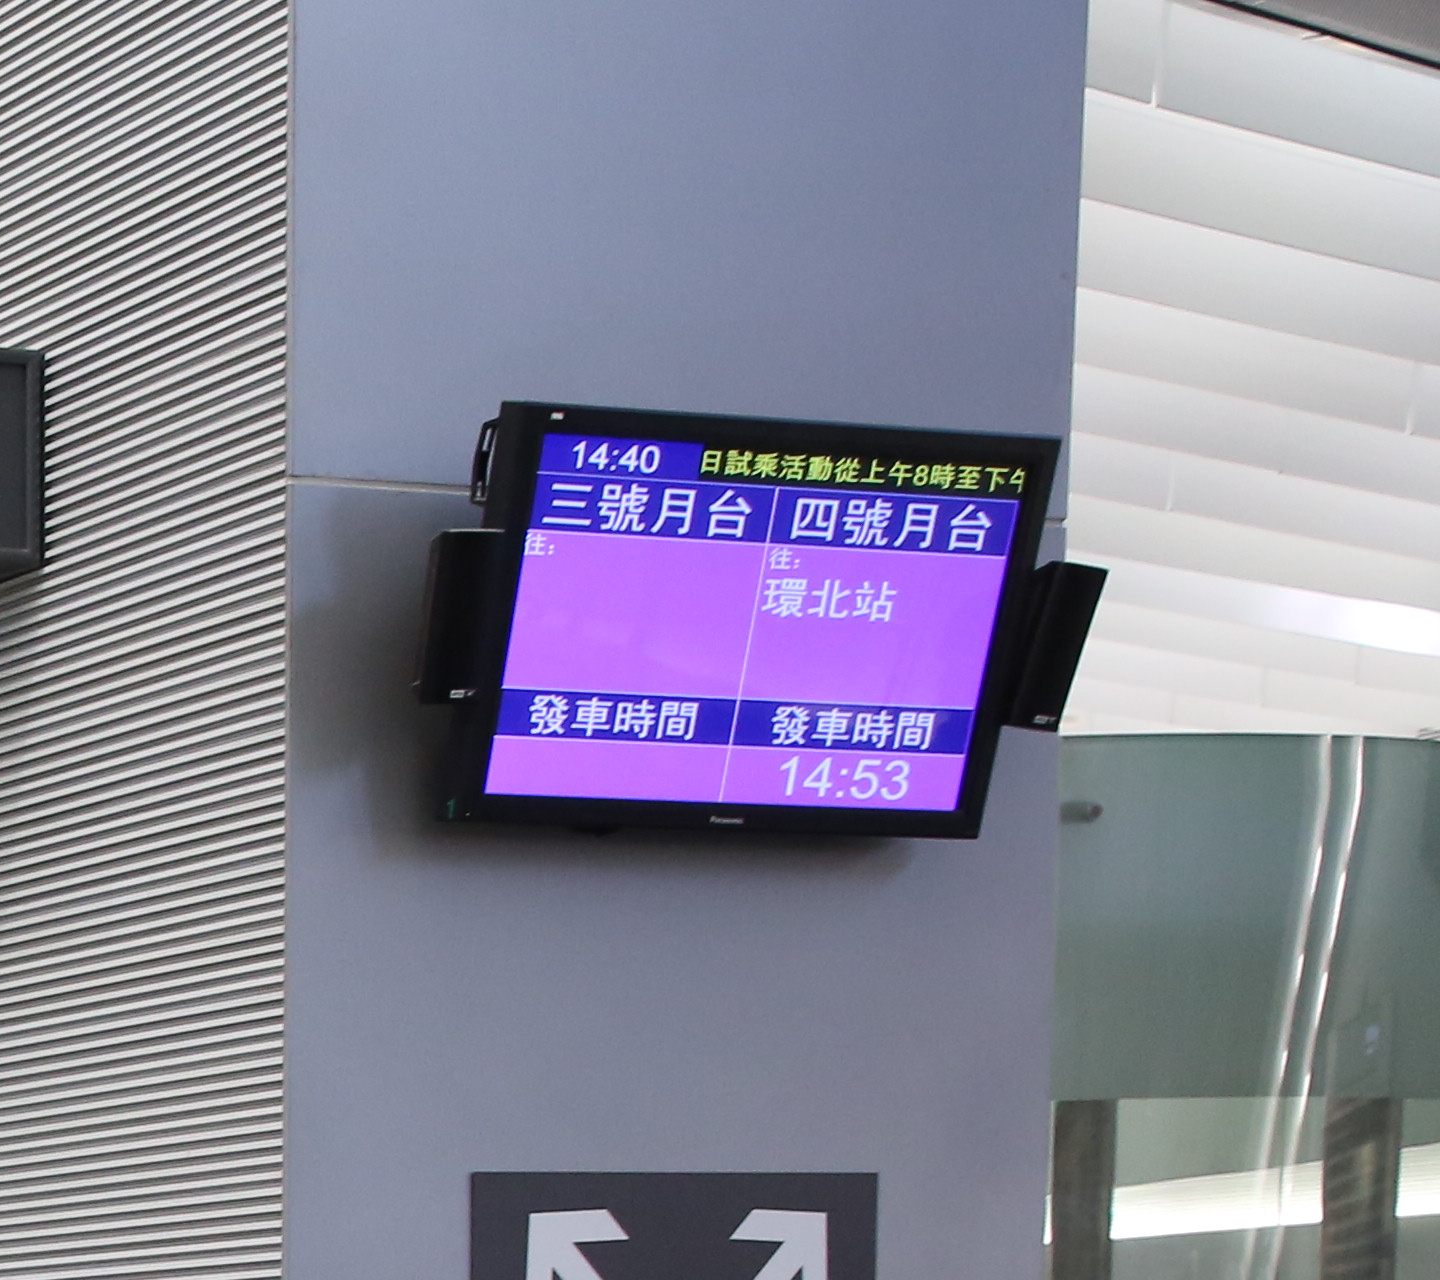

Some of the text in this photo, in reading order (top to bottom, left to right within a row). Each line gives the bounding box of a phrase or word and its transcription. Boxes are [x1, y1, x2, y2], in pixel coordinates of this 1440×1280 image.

[571, 440, 661, 474] 14:40
[541, 480, 754, 539] 三號月台
[790, 496, 994, 553] 四號月台
[760, 577, 898, 624] 環北站
[528, 694, 699, 741] 發車時間
[770, 705, 935, 750] 發車時間
[780, 755, 911, 801] 14:53
